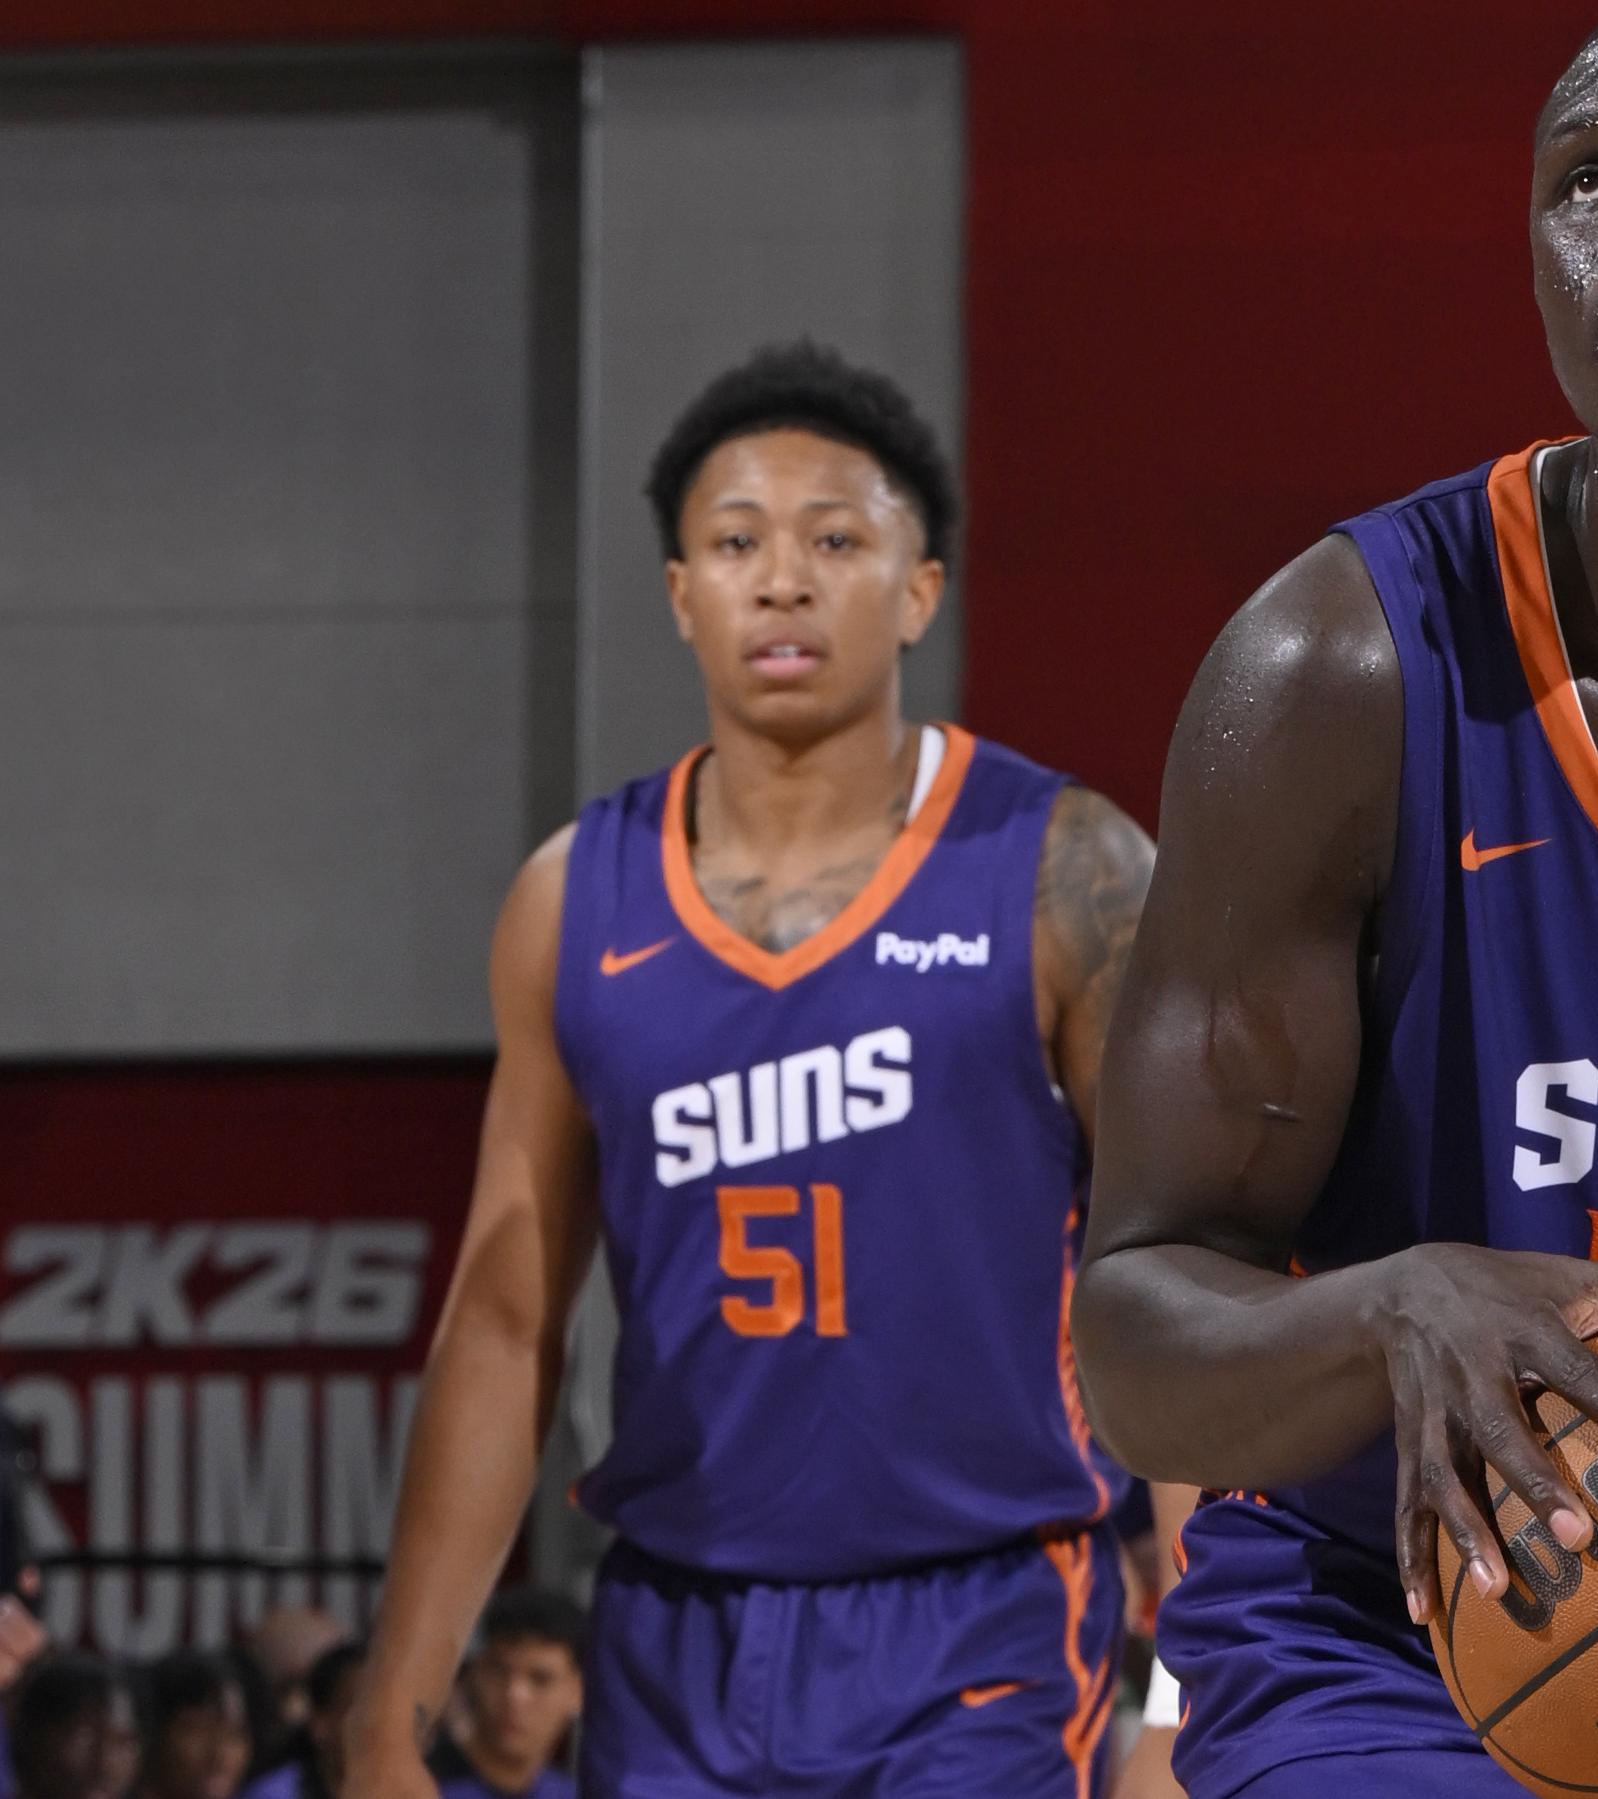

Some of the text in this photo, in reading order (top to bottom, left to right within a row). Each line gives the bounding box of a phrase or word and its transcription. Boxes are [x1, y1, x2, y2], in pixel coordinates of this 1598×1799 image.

[875, 932, 990, 973] PayPal
[0, 1220, 430, 1348] 2K26
[716, 1183, 848, 1339] 51
